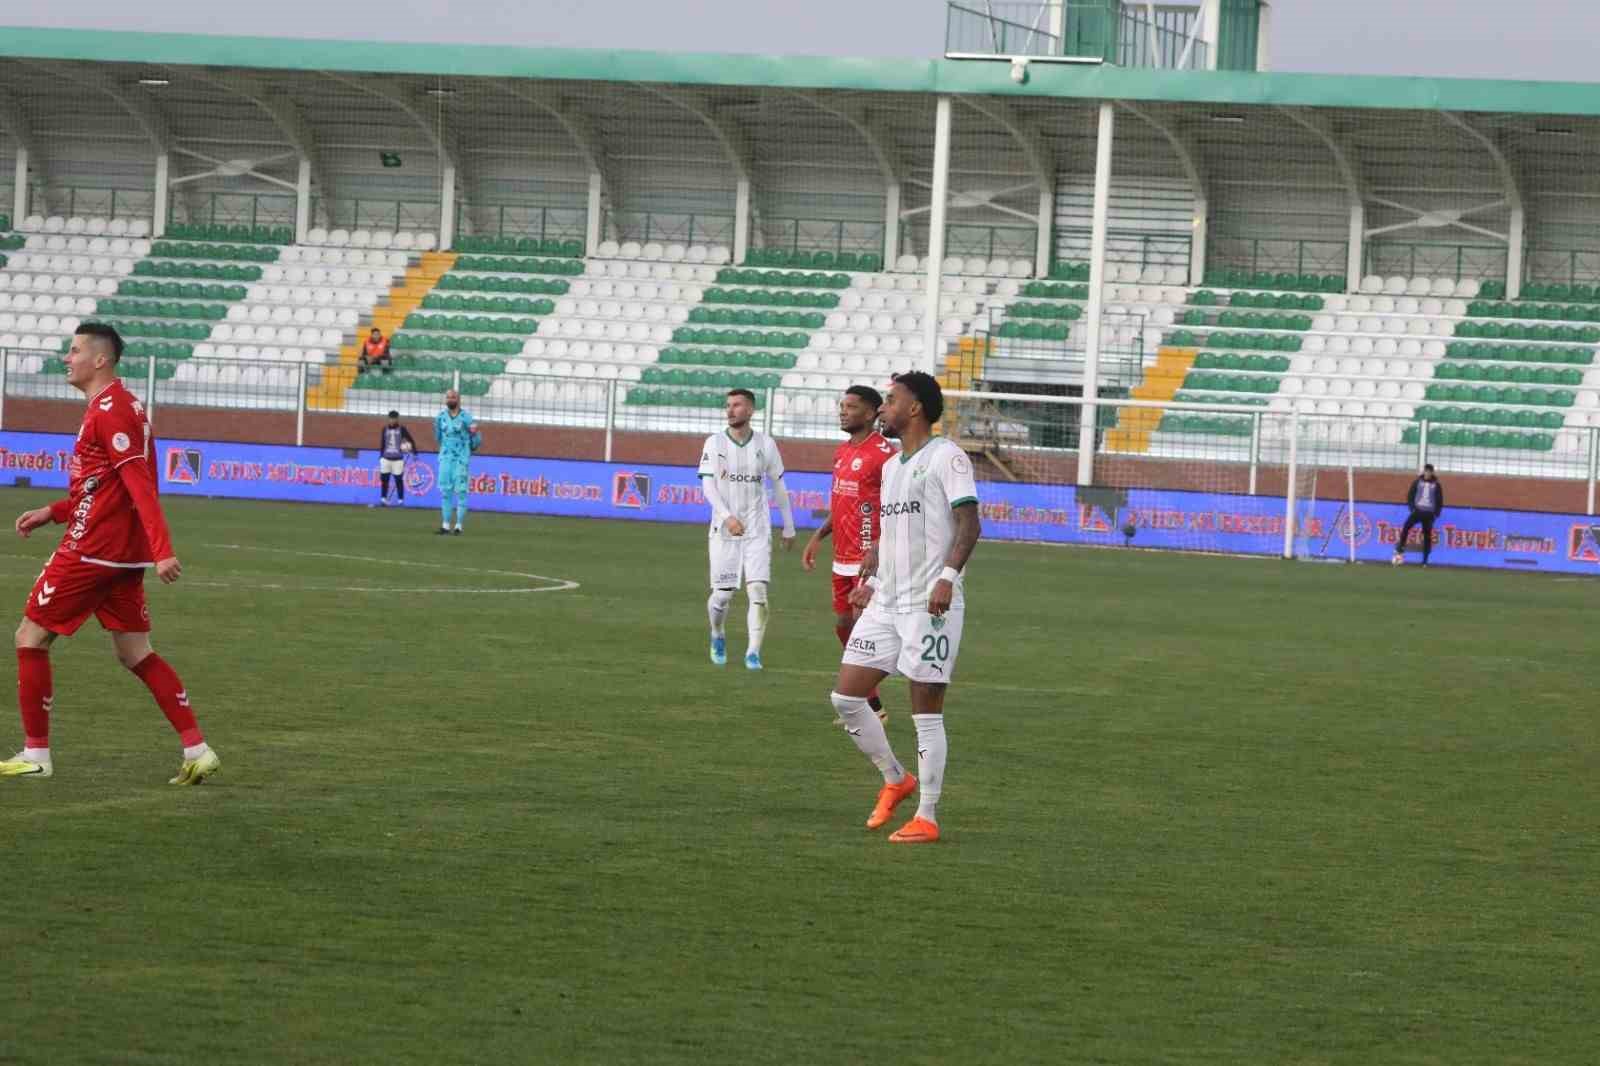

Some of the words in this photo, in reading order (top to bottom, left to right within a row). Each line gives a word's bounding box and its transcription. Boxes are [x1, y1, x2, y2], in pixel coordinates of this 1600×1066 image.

[501, 473, 549, 496] Tavuk
[729, 473, 762, 484] SOCAR
[880, 501, 921, 517] SOCAR
[1443, 524, 1498, 550] Tavuk
[921, 634, 949, 661] 20
